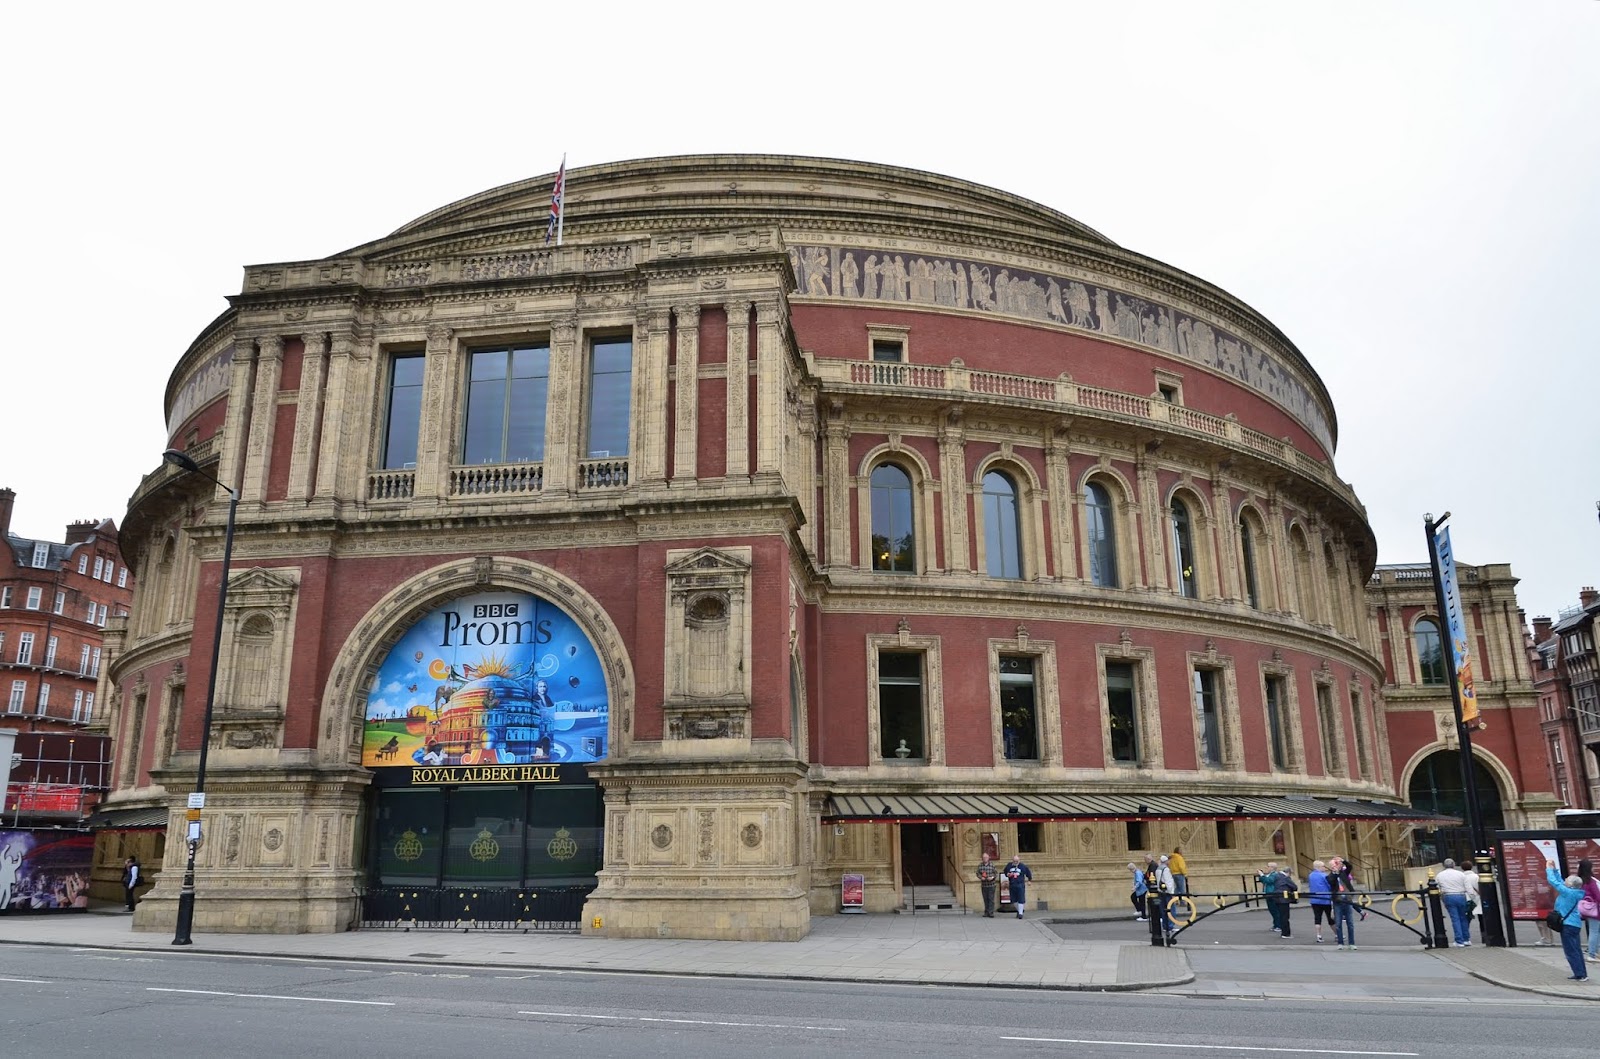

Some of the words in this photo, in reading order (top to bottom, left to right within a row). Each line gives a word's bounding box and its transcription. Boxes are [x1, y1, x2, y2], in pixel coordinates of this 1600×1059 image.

[841, 235, 861, 244] FOR
[878, 238, 898, 247] THE
[914, 243, 986, 258] ADVANCEMENT
[1001, 254, 1013, 262] OF
[1027, 259, 1044, 269] THE
[1092, 274, 1109, 284] AND
[474, 604, 518, 618] BBC
[438, 611, 552, 647] Proms
[412, 768, 459, 782] ROYAL
[462, 767, 518, 782] ALBERT
[521, 766, 560, 781] HALL
